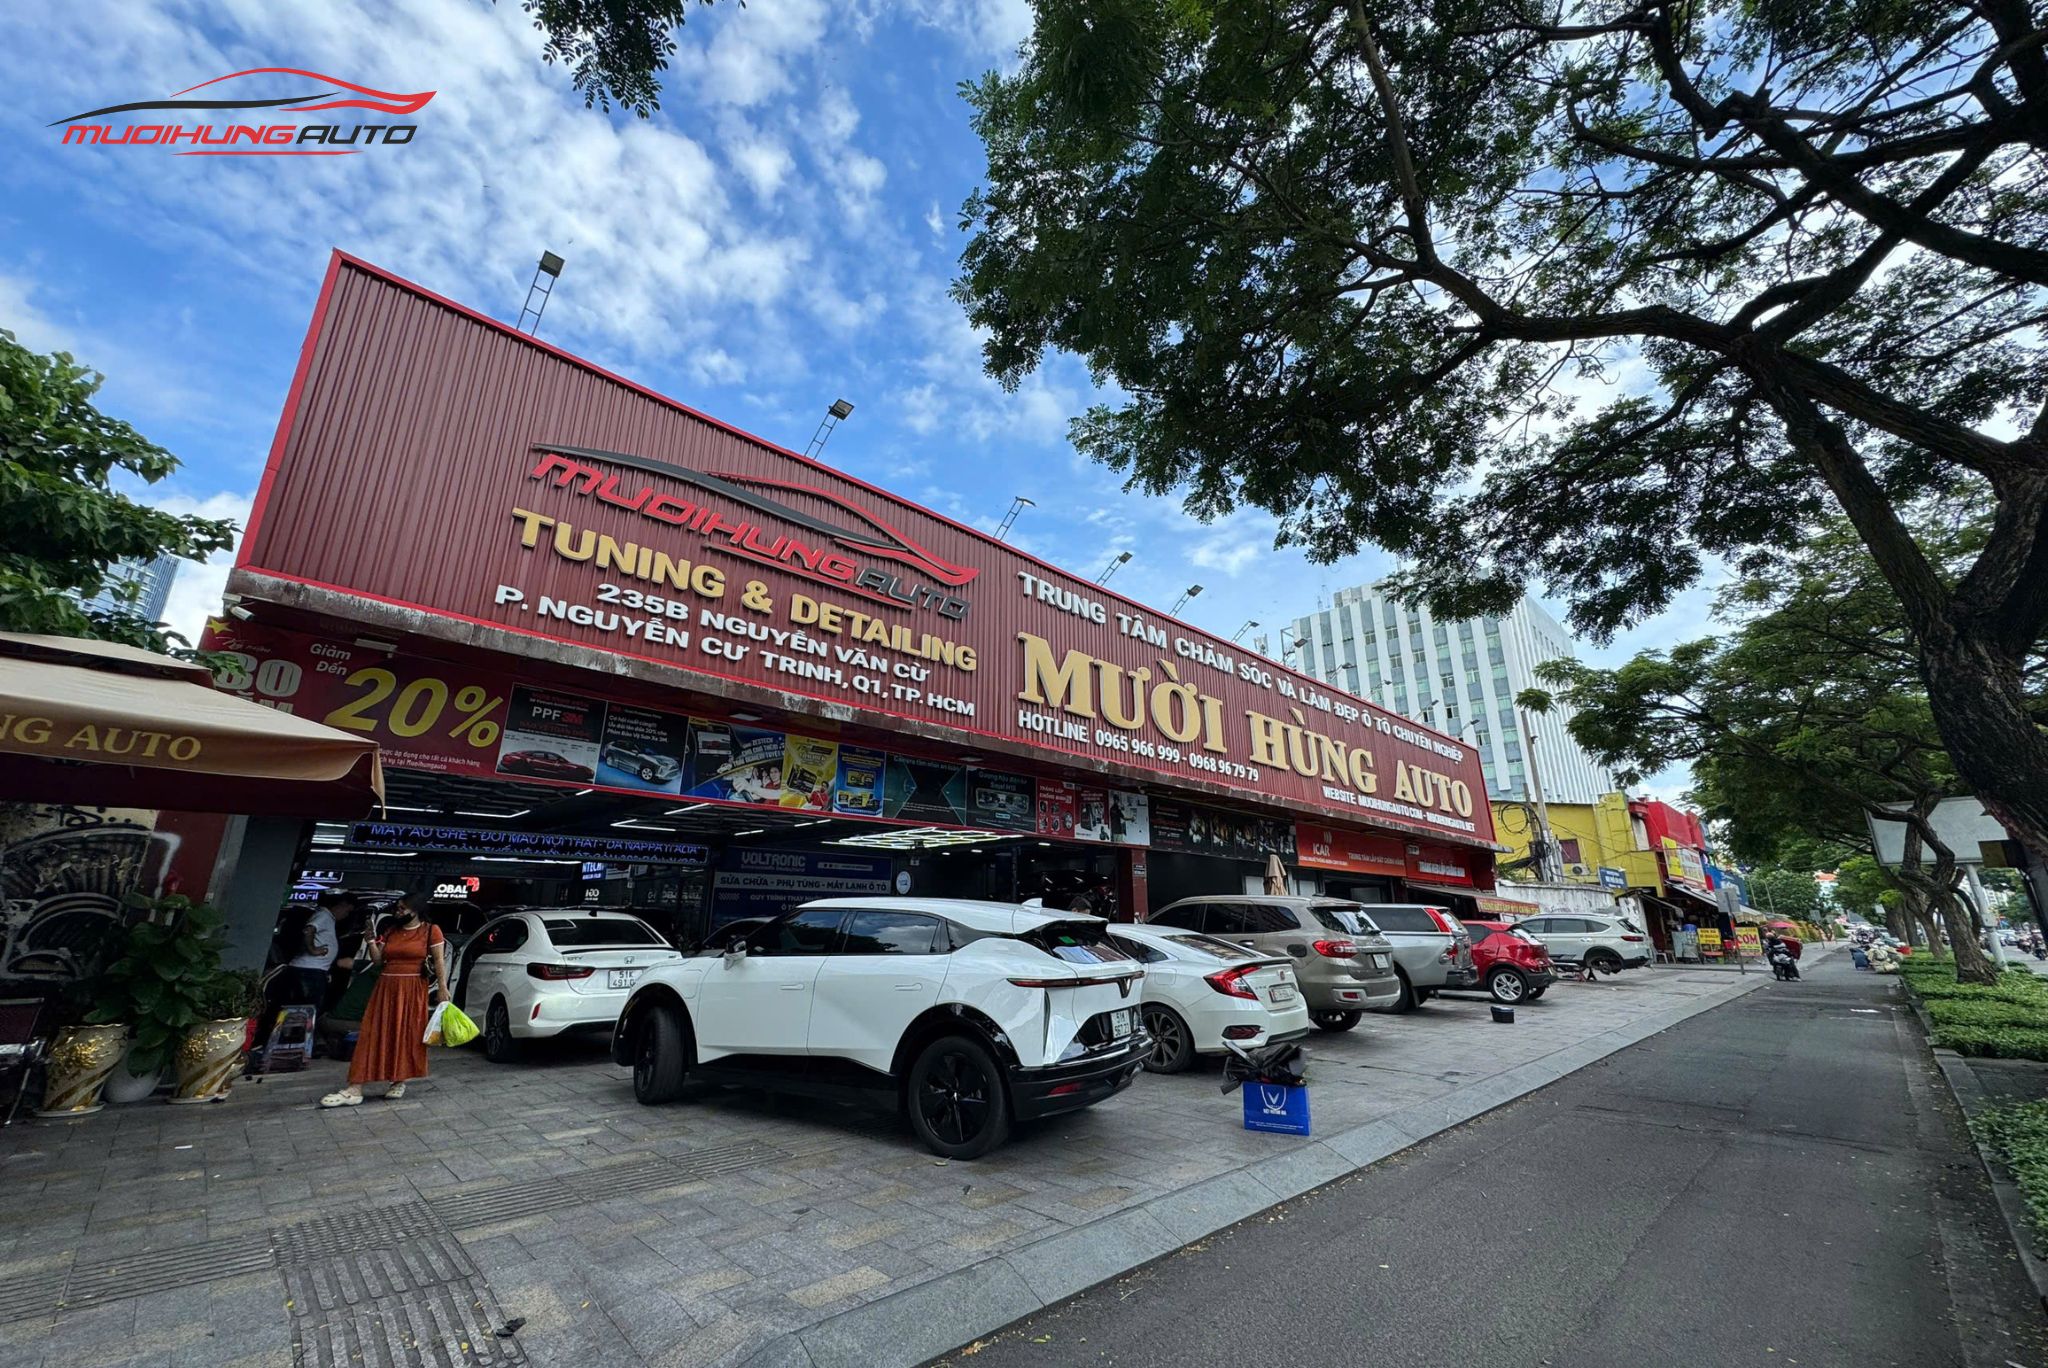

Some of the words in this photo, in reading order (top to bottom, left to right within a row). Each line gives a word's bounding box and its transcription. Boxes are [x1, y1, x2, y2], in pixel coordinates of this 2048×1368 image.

[531, 452, 970, 620] MUOIHUNGAUTO
[512, 507, 726, 599] TUNING
[741, 580, 773, 614] &
[790, 593, 977, 672] DETAILING
[310, 643, 352, 661] Giảm
[316, 660, 348, 677] Đến
[494, 584, 528, 610] P.
[537, 596, 689, 648] NGUYỄN
[701, 636, 749, 661] CƯ
[927, 692, 975, 717] HCM
[597, 583, 689, 620] 235B
[700, 609, 828, 658] NGUYỄN
[835, 645, 888, 673] VĂN
[893, 662, 931, 683] CỪ
[1018, 571, 1106, 624] TRUNG
[1116, 614, 1167, 649] TÂM
[1174, 637, 1234, 674] CHĂM
[1238, 662, 1272, 689] SÓC
[1277, 677, 1297, 699] VÀ
[1299, 686, 1331, 713] LÀM
[1333, 701, 1359, 724] ĐẸP
[1361, 709, 1372, 728] Ô
[1374, 716, 1391, 735] TÔ
[1392, 725, 1432, 751] CHUYÊN
[1433, 740, 1464, 764] NGHIỆP
[64, 723, 201, 761] AUTO
[323, 667, 503, 748] 20%
[531, 706, 562, 721] PPF
[1017, 631, 1227, 754] MƯỜI
[1245, 707, 1377, 794] HÙNG
[1393, 759, 1473, 818] AUTO
[1095, 729, 1128, 752] 0965
[1131, 738, 1155, 758] 966
[1157, 745, 1180, 763] 999
[1189, 752, 1216, 772] 0968
[1312, 843, 1331, 857] ICAR
